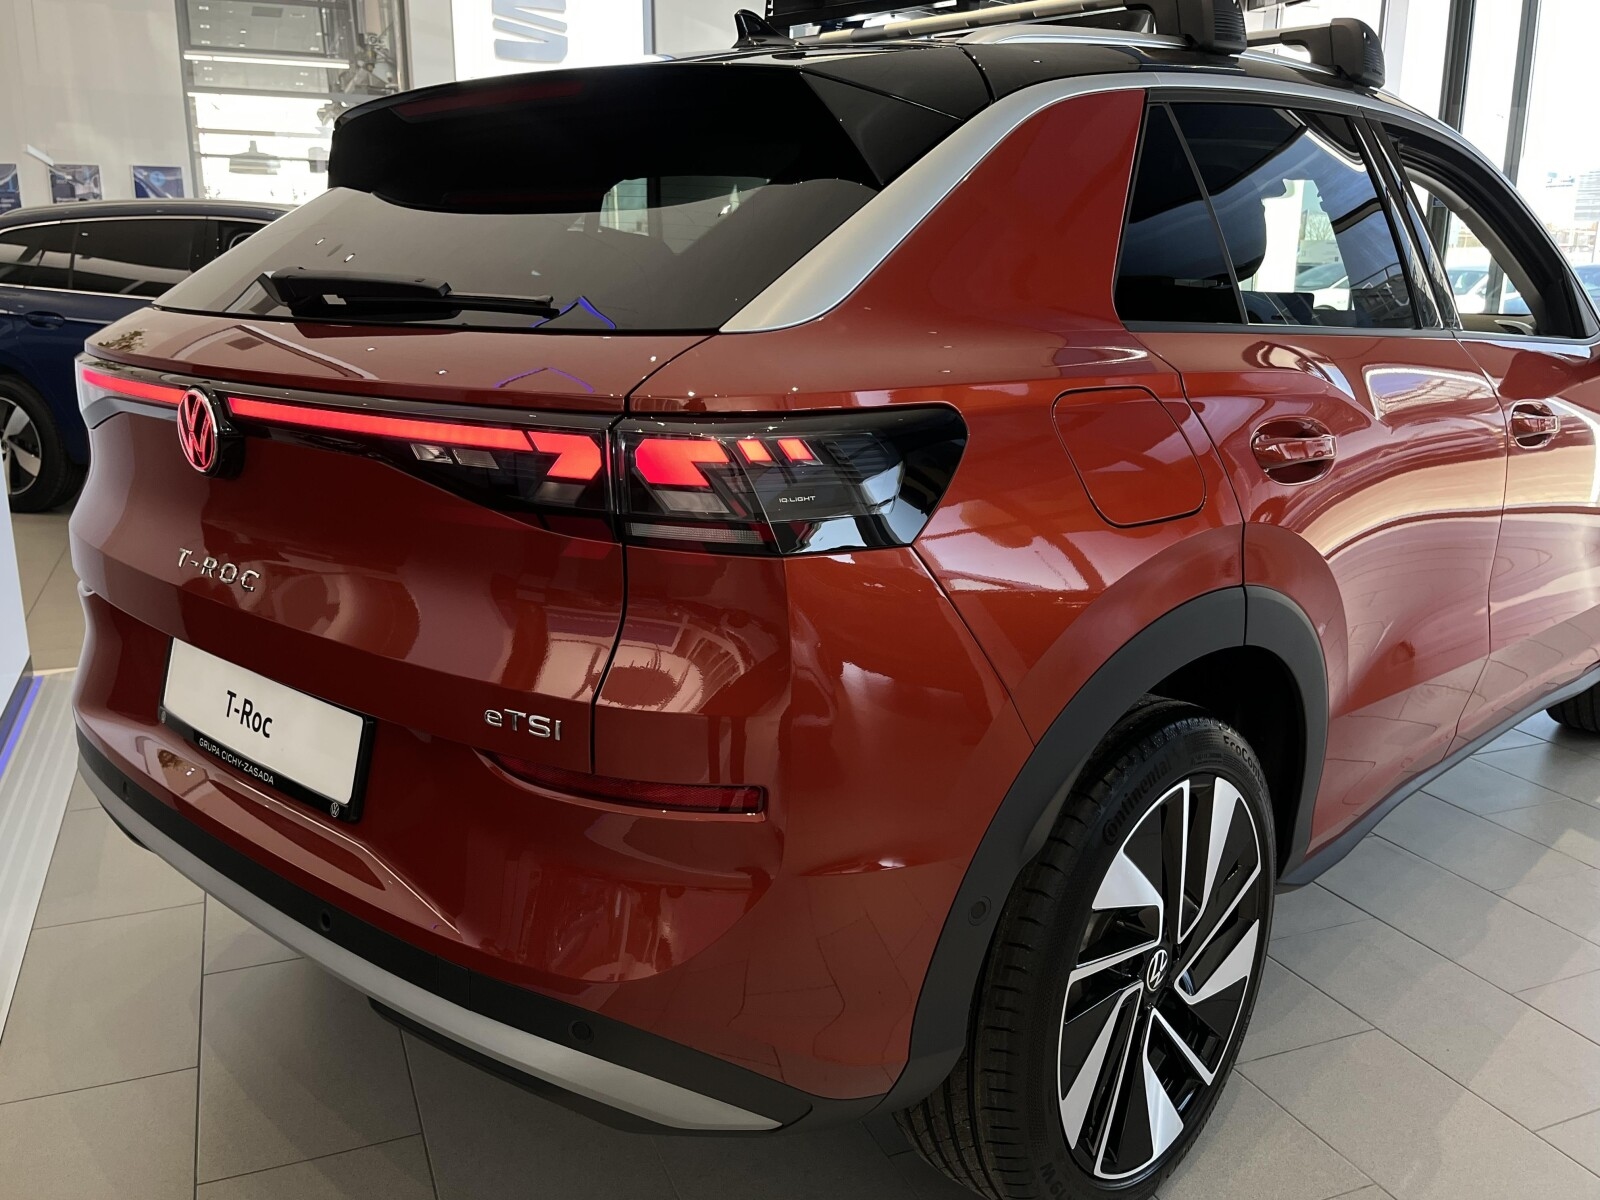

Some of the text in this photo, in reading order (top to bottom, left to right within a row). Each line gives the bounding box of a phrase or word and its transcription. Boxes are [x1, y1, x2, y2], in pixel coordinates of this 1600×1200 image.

[177, 547, 261, 593] T-ROC
[226, 690, 273, 738] T-Roc
[484, 708, 562, 741] eTSI
[199, 737, 274, 786] GRUPA CICHY-ZASADA
[1102, 757, 1173, 846] Continental
